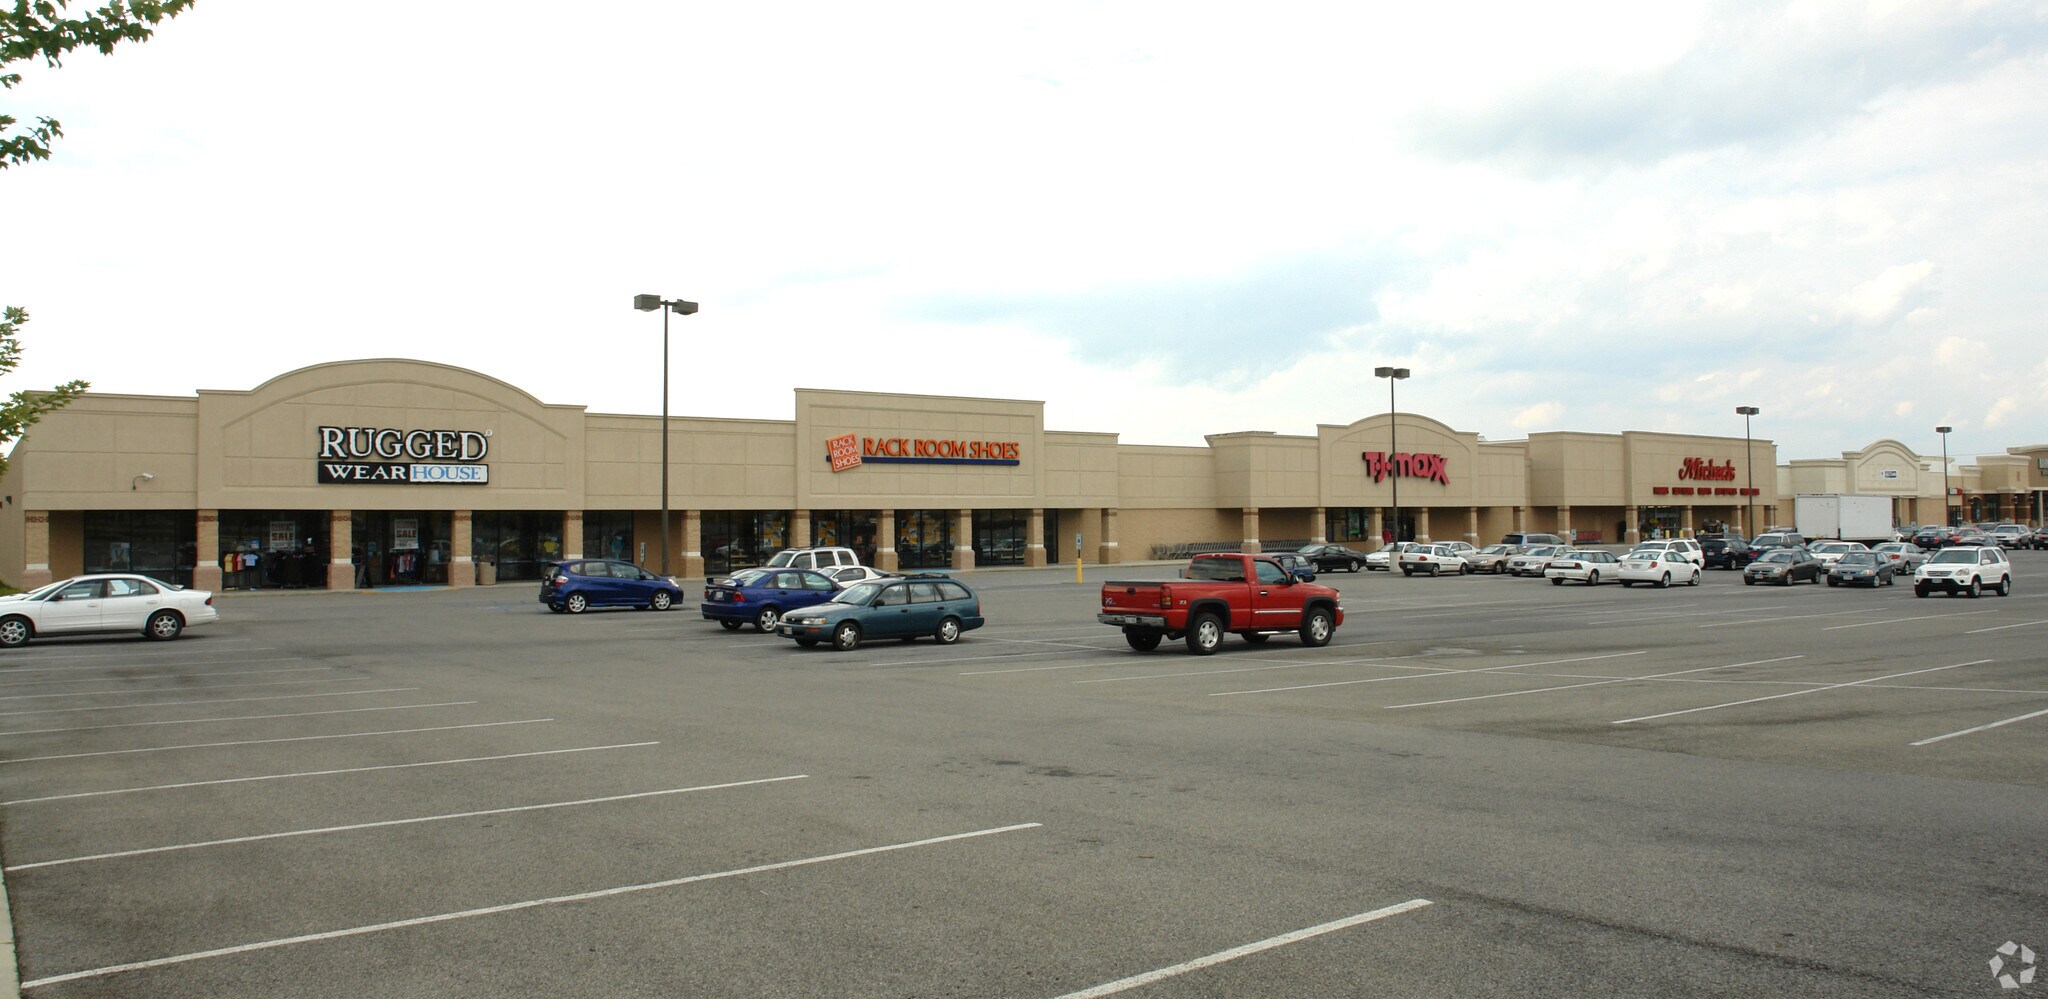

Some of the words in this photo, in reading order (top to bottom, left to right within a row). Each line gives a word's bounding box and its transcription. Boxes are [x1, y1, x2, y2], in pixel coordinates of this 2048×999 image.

[319, 426, 488, 461] RUGGED
[832, 436, 855, 449] RACK
[863, 437, 911, 457] RACK
[914, 439, 967, 458] ROOM
[969, 441, 1020, 460] SHOES
[833, 445, 858, 458] ROOM
[835, 454, 860, 469] SHOES
[1678, 457, 1735, 481] Michaels
[324, 464, 407, 480] WEAR
[412, 465, 482, 480] HOUSE
[271, 532, 294, 541] SALE
[396, 529, 417, 539] SALE
